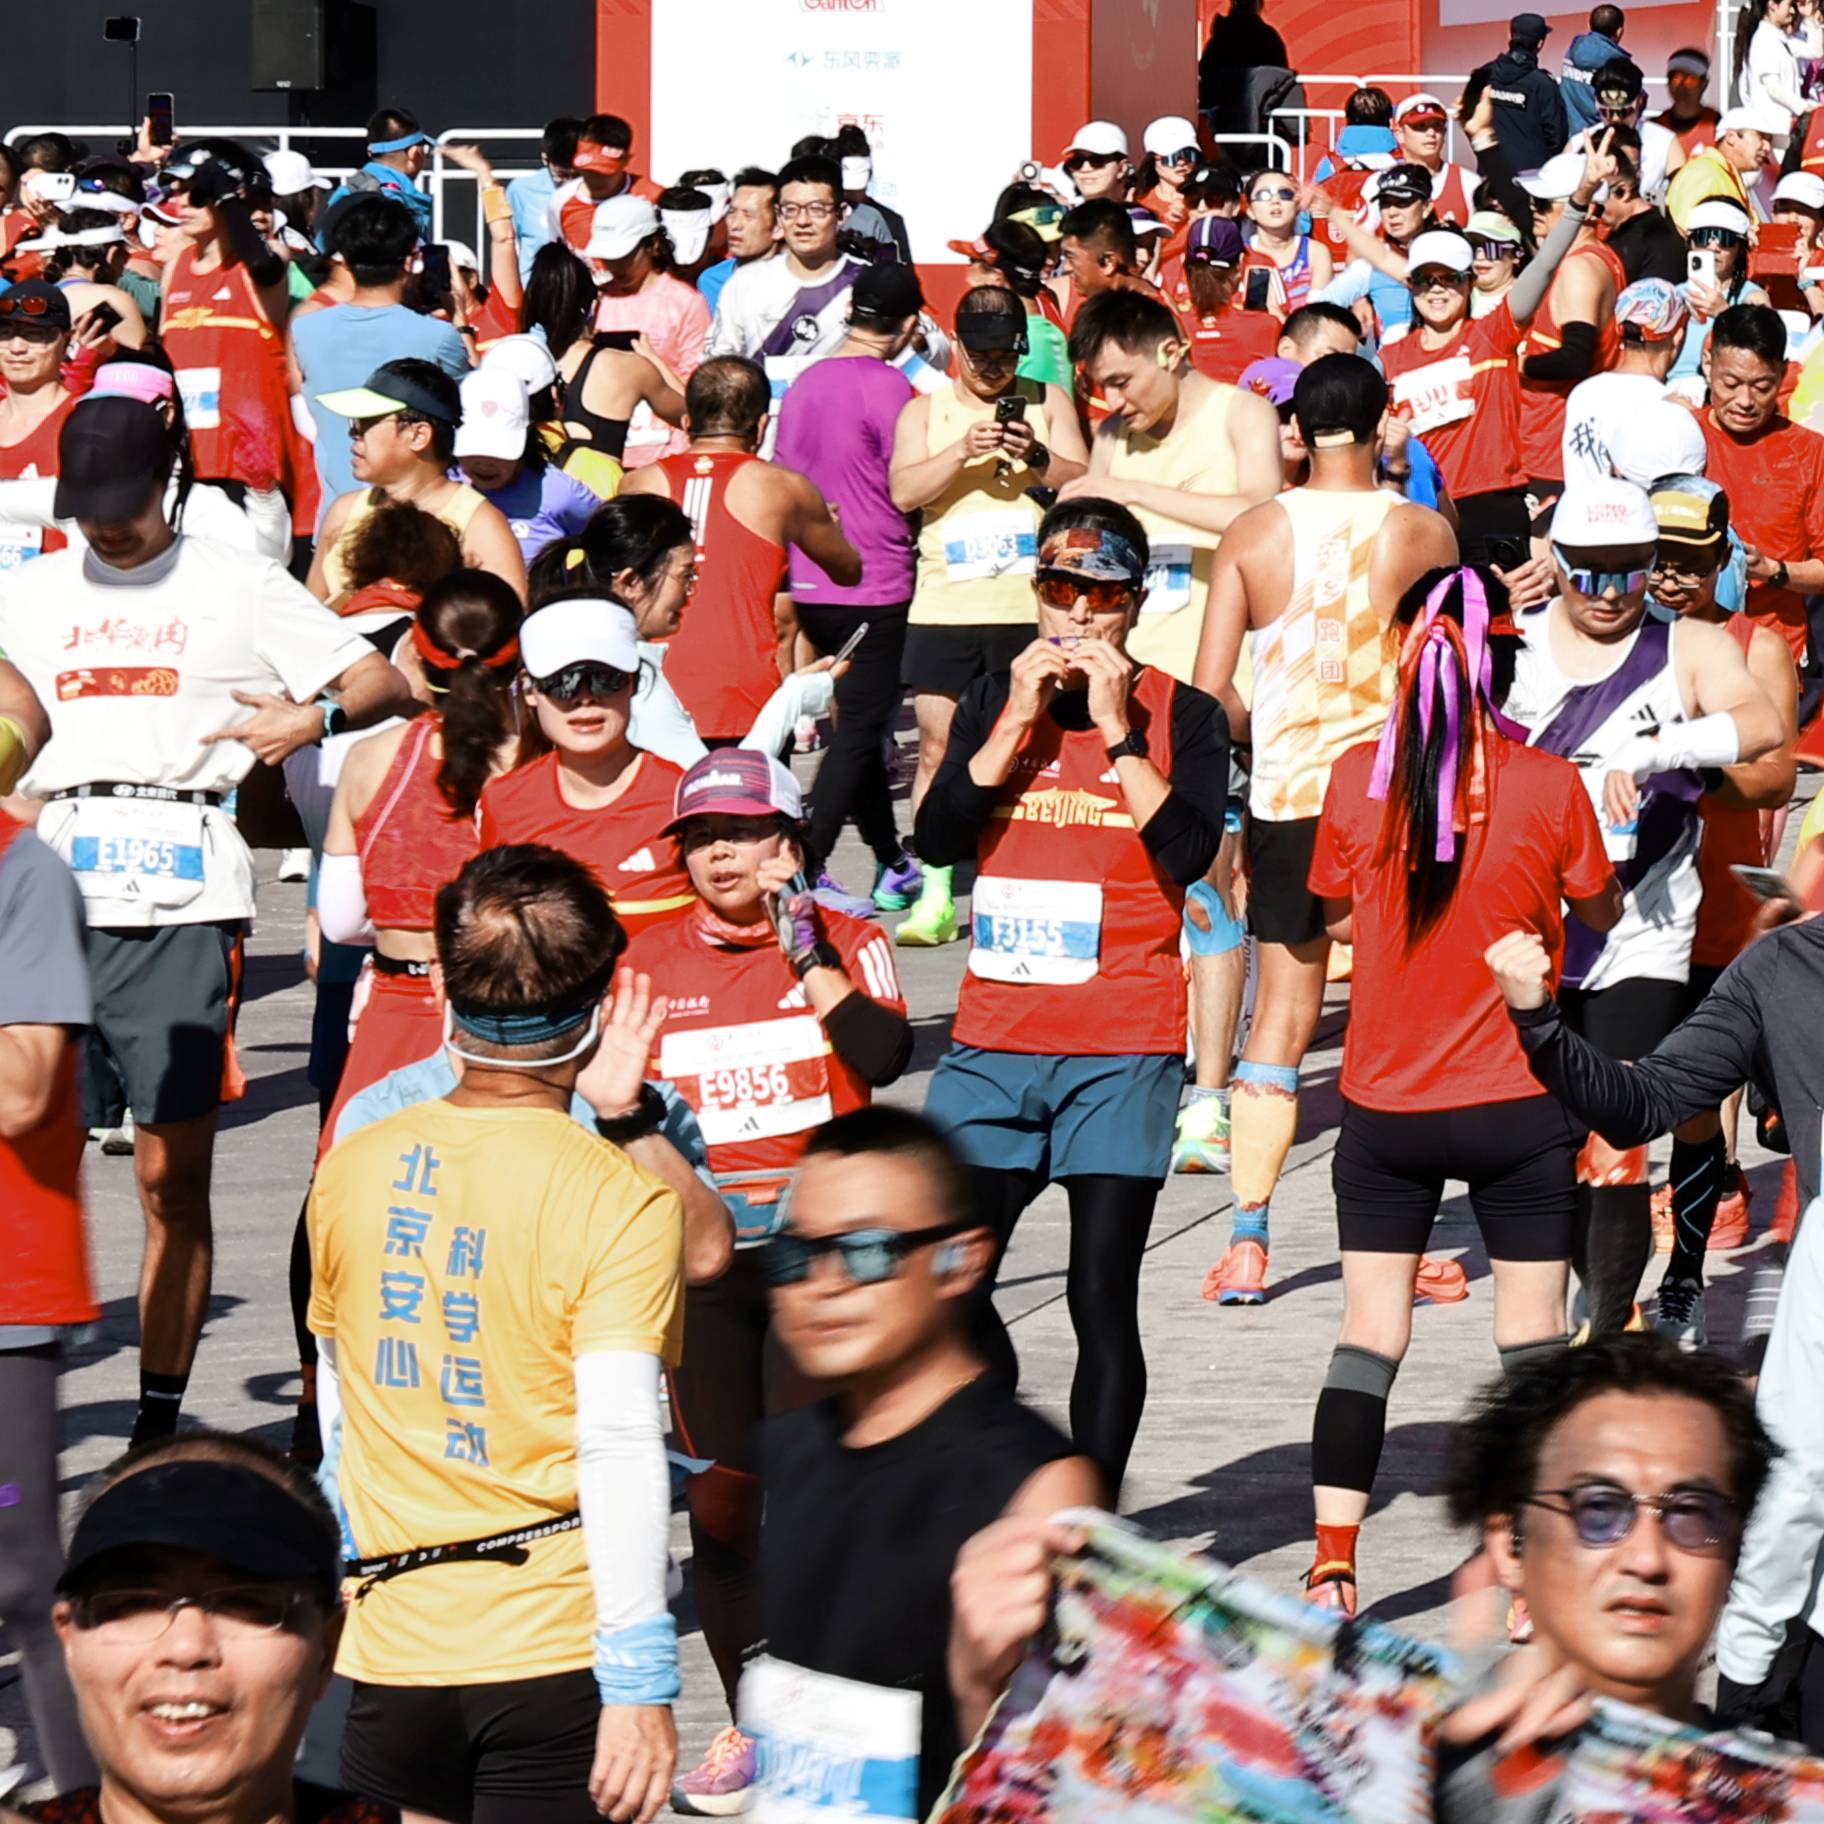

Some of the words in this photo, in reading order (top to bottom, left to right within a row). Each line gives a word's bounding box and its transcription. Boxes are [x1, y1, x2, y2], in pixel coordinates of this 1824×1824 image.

[1024, 793, 1103, 828] BEIJING
[102, 837, 175, 869] E1965
[700, 1063, 790, 1107] E9856
[375, 1143, 440, 1391] 北京安心
[441, 1226, 489, 1470] 科学运动
